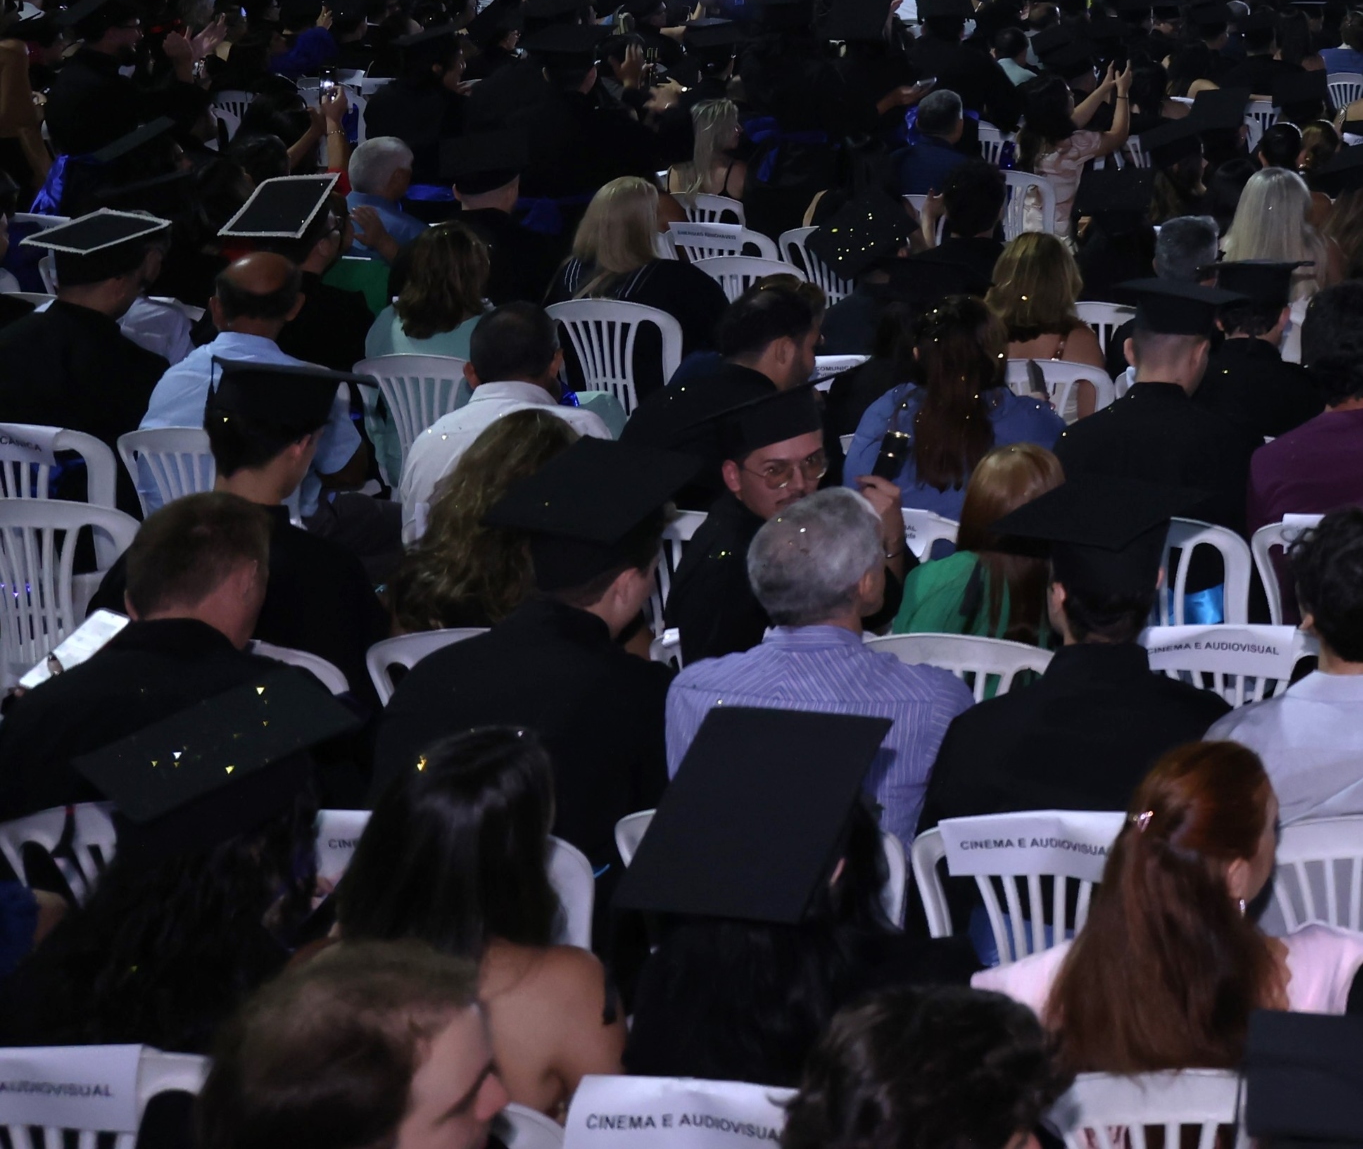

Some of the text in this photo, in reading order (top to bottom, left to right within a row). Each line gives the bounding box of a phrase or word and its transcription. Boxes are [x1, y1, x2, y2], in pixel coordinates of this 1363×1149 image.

[1194, 641, 1202, 650] E
[1204, 641, 1280, 656] AUDIOVISUAL
[960, 837, 1107, 856] CINEMA E AUDIOVISUA
[586, 1113, 783, 1142] CINEMA E AUDIOVISUA
